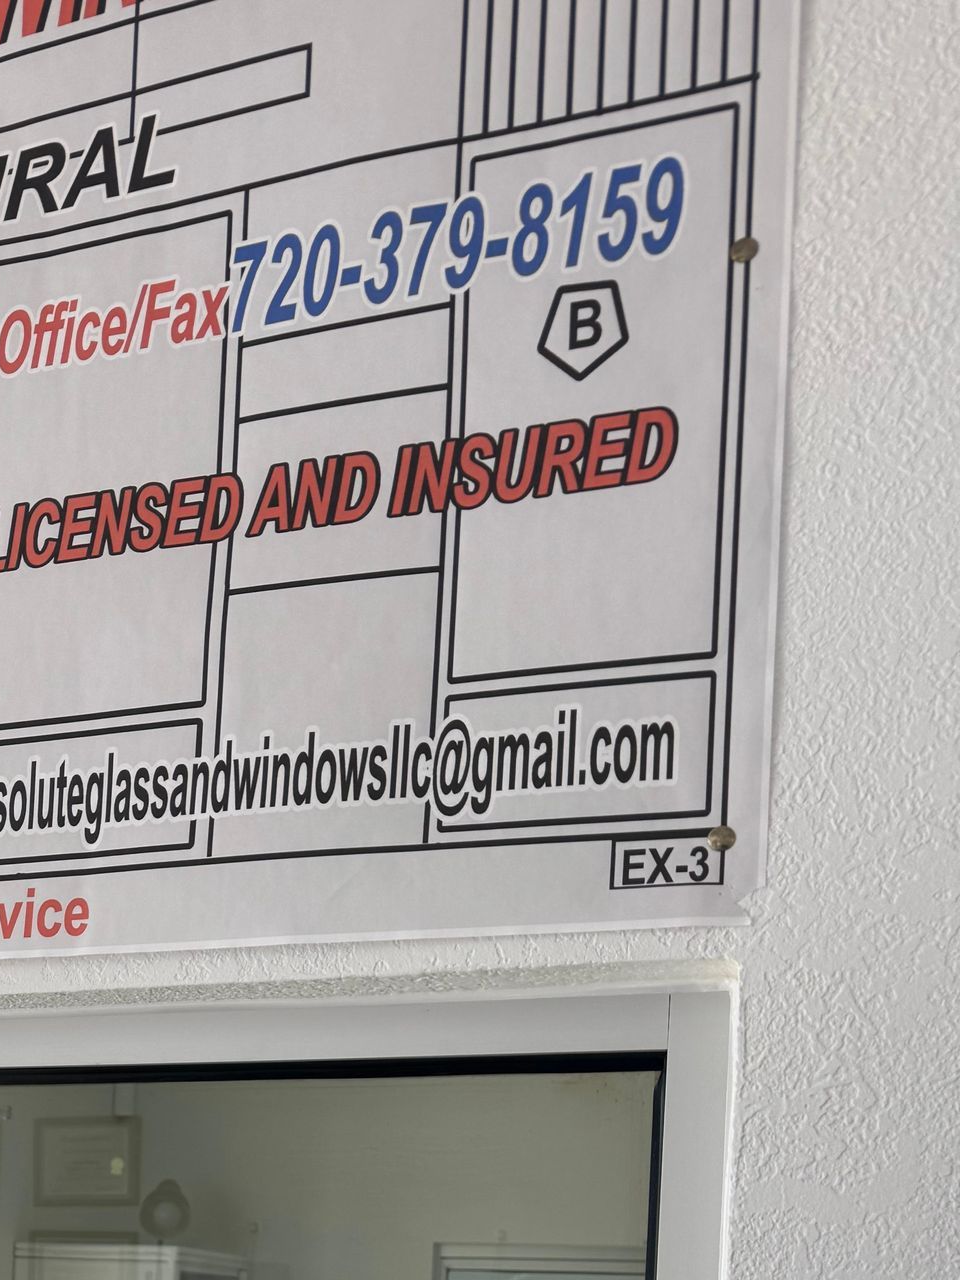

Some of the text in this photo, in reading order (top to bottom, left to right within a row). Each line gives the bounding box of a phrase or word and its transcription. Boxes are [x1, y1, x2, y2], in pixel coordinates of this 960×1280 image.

[232, 156, 685, 333] 720-379-8159
[568, 298, 603, 351] B
[244, 450, 382, 538] AND
[386, 406, 680, 518] INSURED
[621, 846, 710, 886] EX-3
